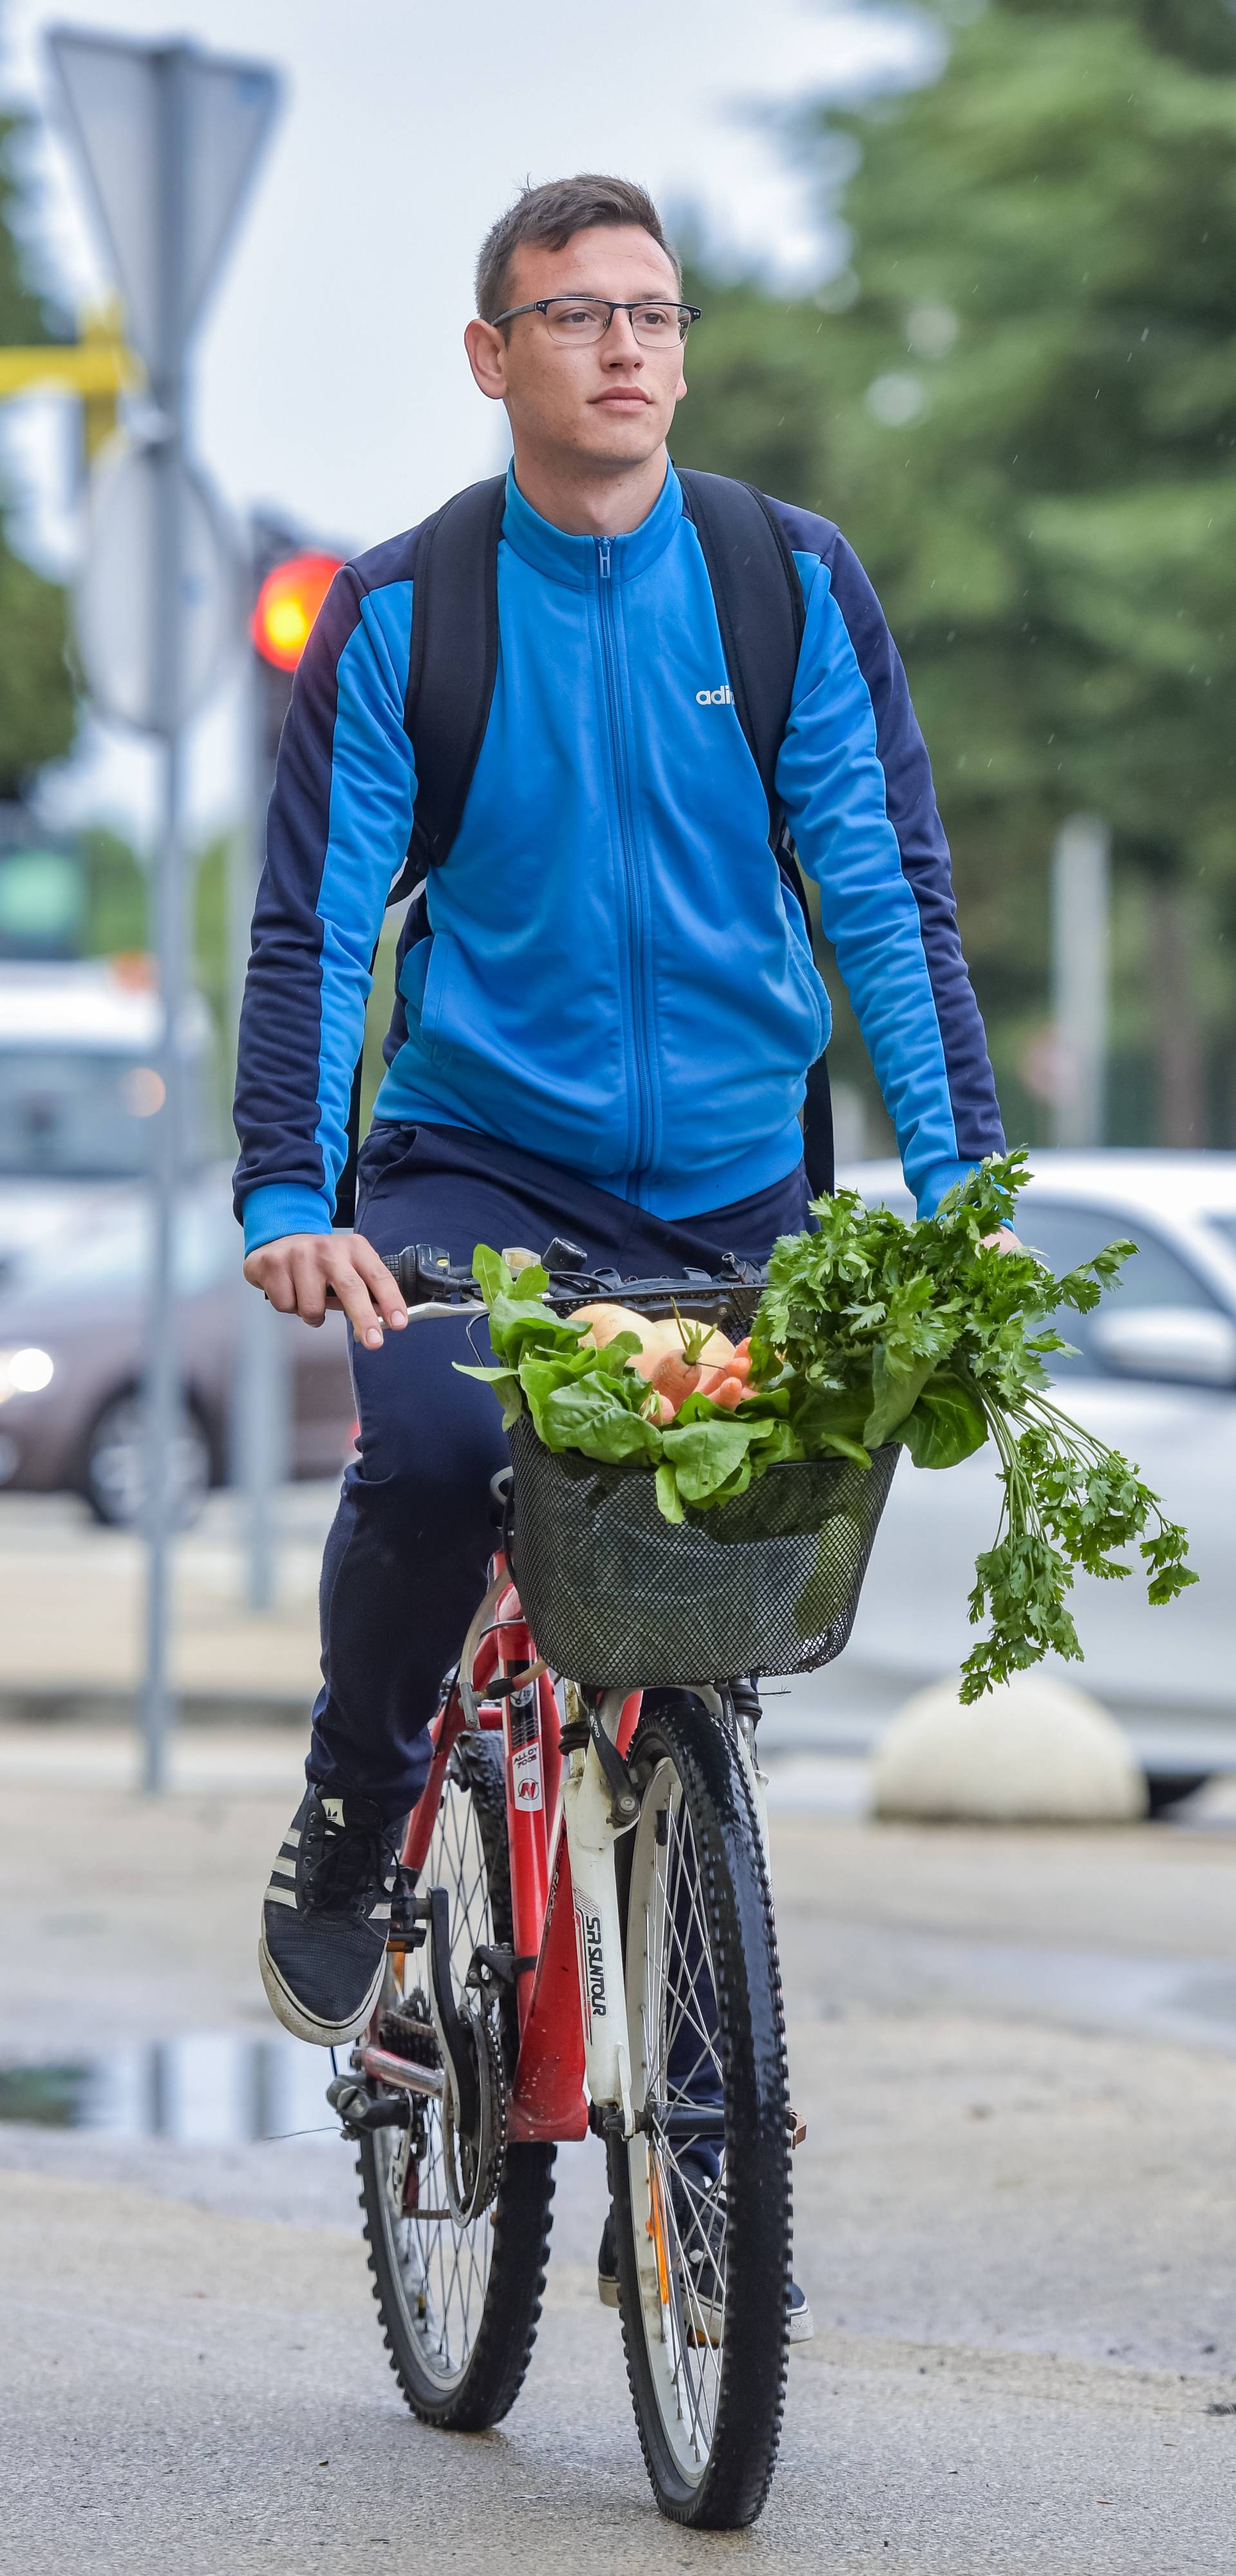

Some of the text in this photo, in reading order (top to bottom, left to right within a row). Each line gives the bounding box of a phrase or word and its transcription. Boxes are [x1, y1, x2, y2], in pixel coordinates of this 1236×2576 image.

[696, 685, 735, 705] adi
[514, 1747, 537, 1765] ALLOY
[517, 1754, 536, 1769] 7005
[586, 1915, 606, 2016] SR SUNTOUR
